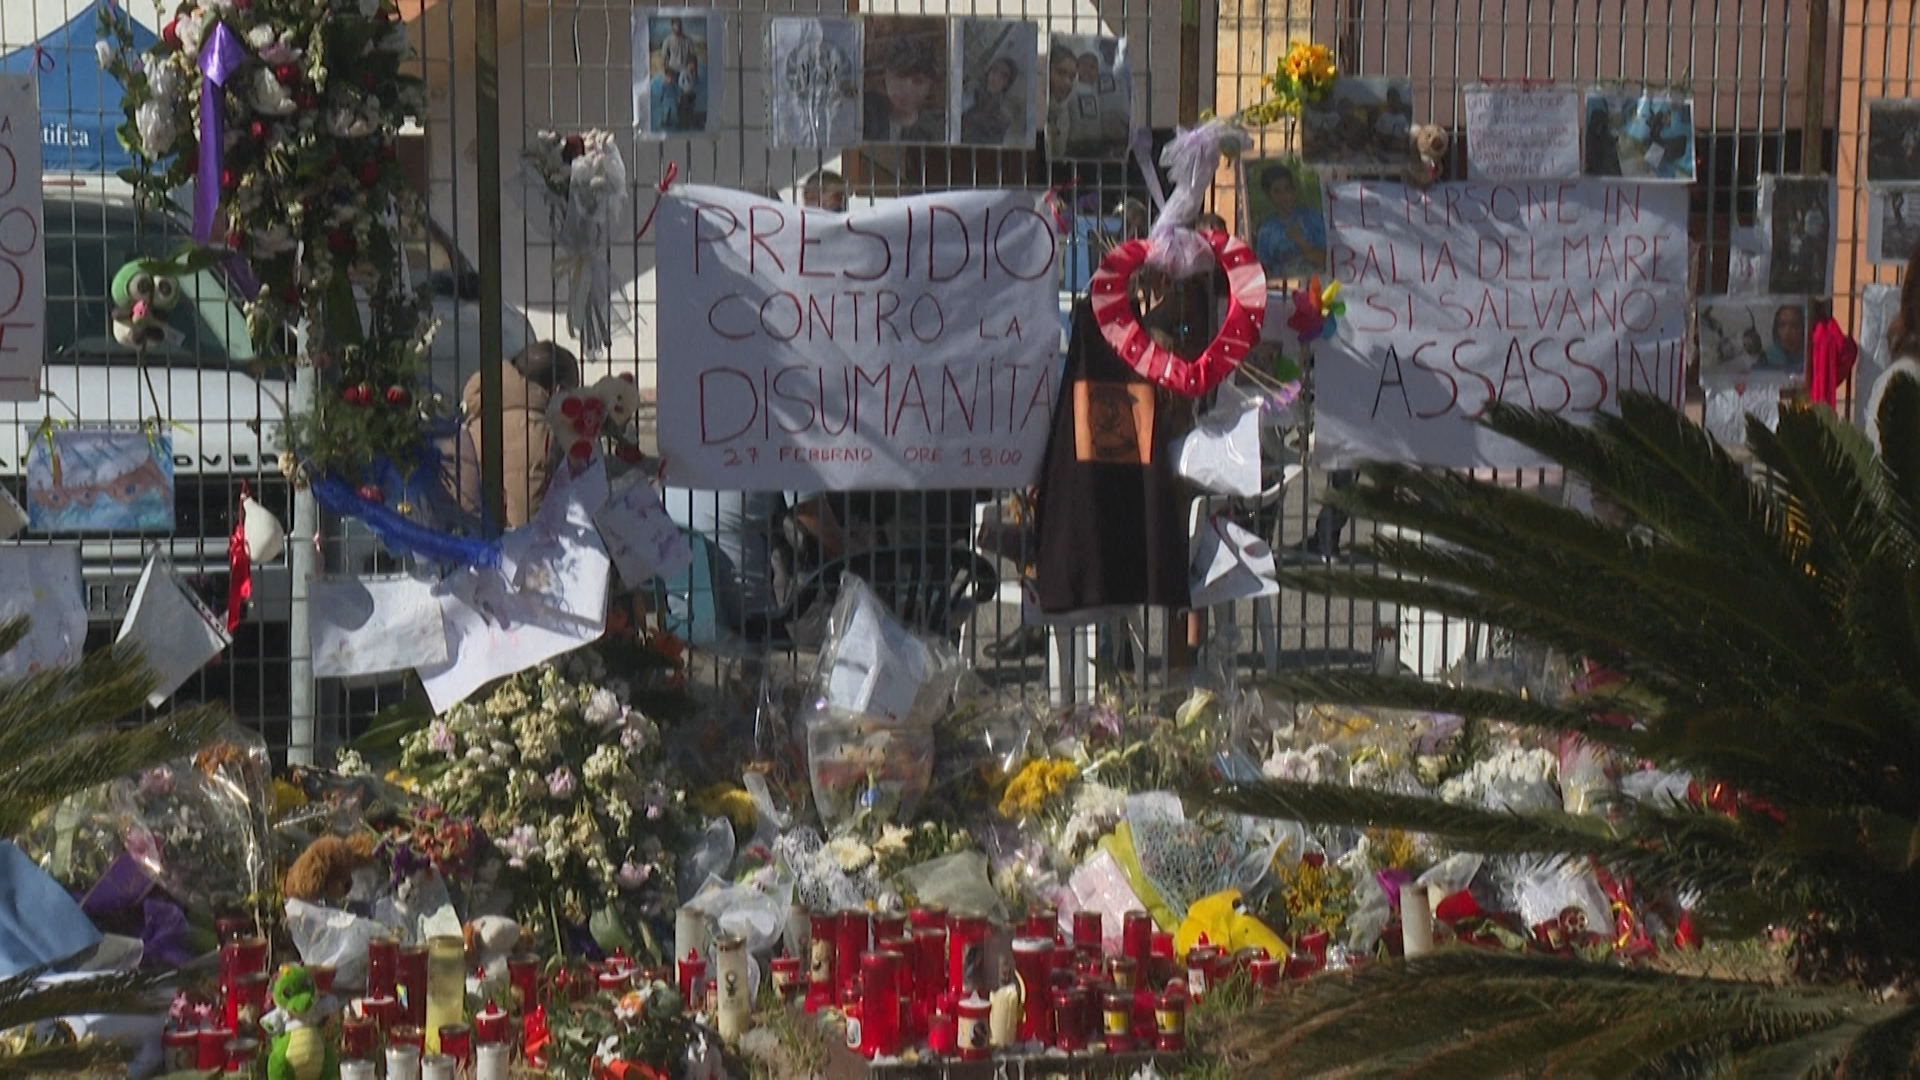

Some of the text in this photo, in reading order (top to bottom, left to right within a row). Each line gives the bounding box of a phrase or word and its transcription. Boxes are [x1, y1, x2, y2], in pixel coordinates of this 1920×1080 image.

[41, 122, 89, 147] tifica
[1326, 181, 1641, 229] LE PERSONE IN
[694, 202, 1055, 282] PRESIDIO
[1330, 233, 1671, 286] BALIA DEL MARE
[707, 289, 1022, 346] CONTRO LA
[1357, 291, 1414, 332] SI
[723, 446, 758, 467] 27
[903, 446, 943, 464] ORE
